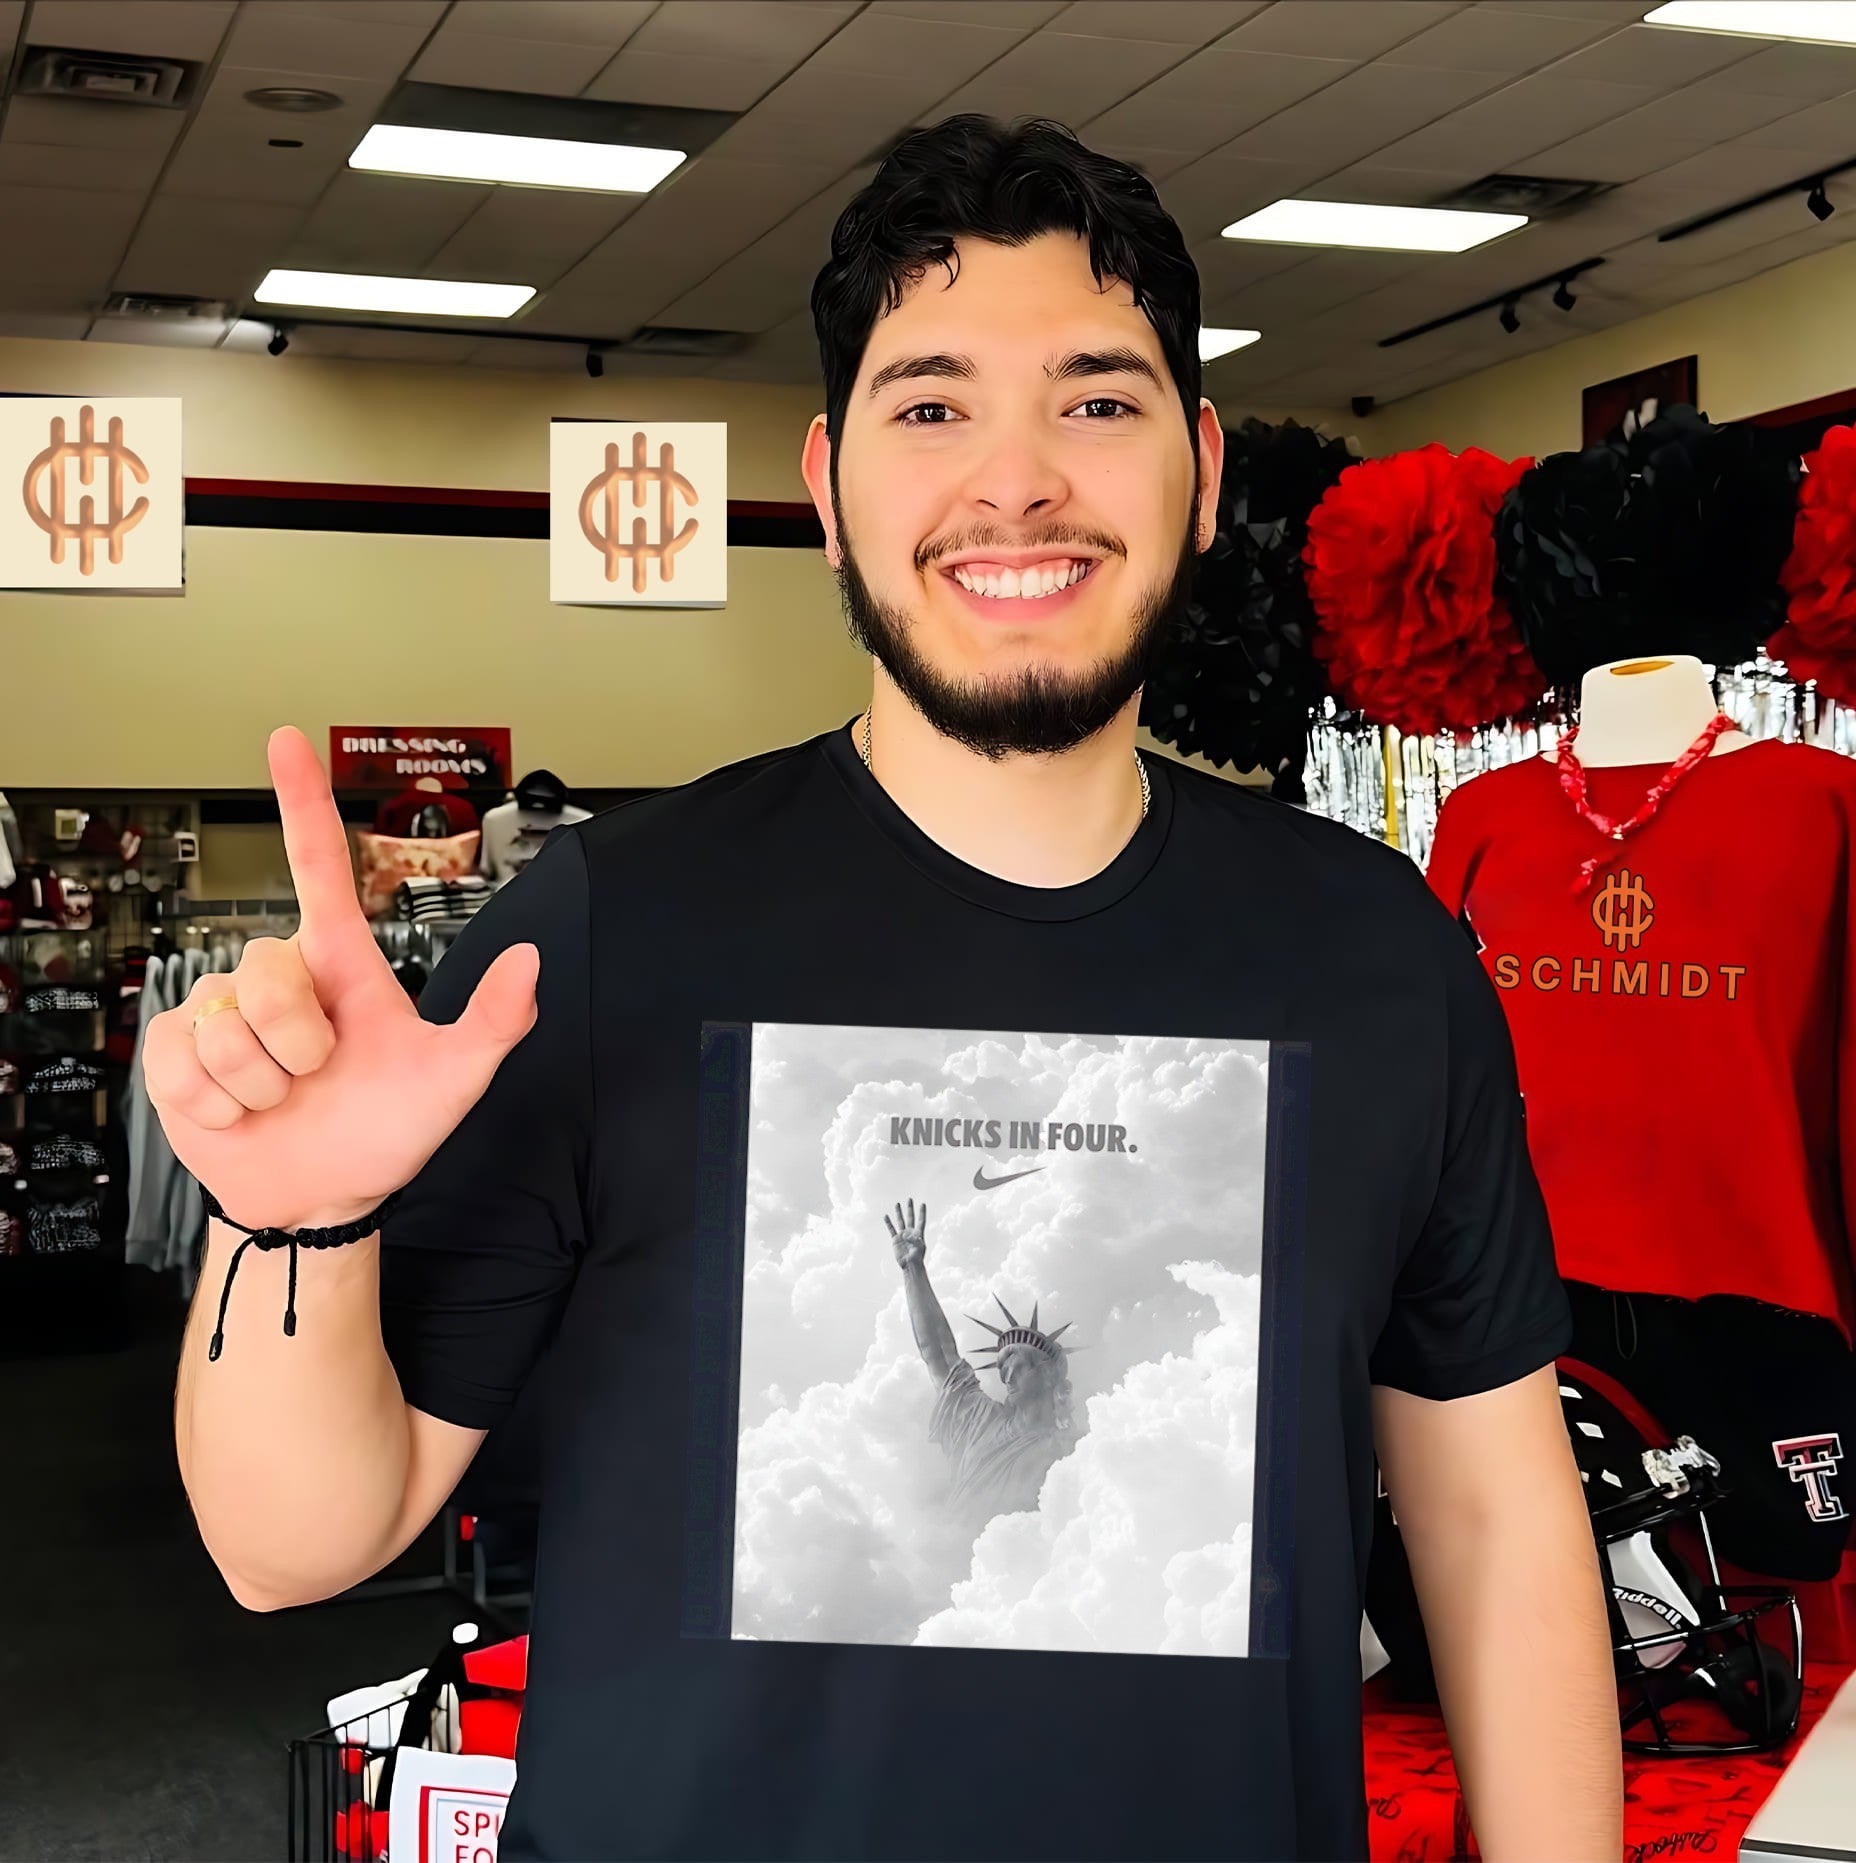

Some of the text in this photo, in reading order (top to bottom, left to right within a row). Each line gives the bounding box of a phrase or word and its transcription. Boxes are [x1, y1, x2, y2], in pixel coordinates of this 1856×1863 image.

[342, 737, 467, 754] DRESSING
[396, 758, 488, 775] ROOMS
[1494, 953, 1747, 1000] SCHMIDT
[890, 1116, 1138, 1153] KNICKS IN FOUR.
